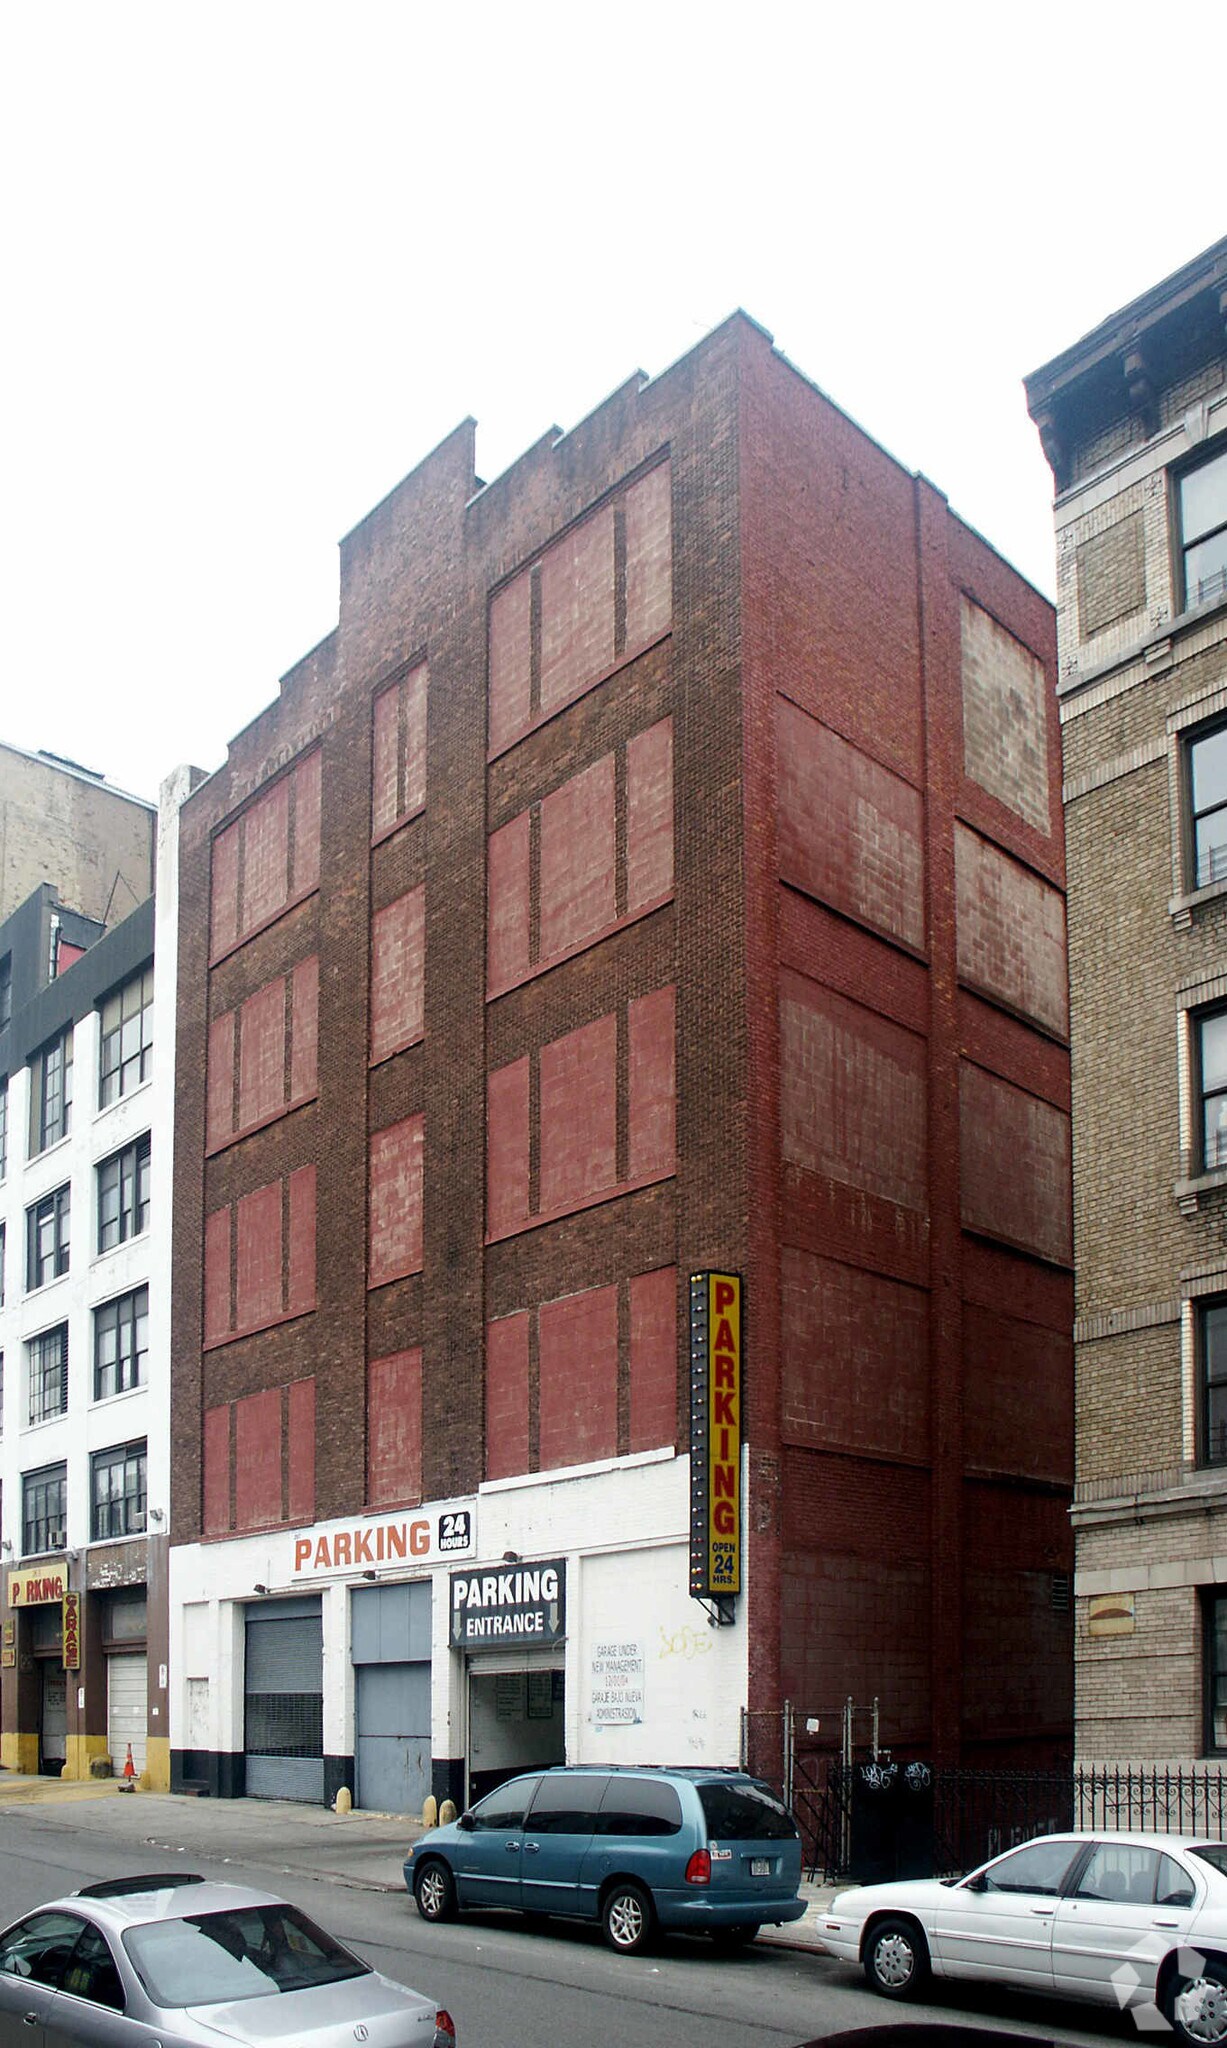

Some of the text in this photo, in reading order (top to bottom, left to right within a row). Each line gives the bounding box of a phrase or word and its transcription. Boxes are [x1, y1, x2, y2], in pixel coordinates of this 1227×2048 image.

[714, 1281, 736, 1536] PARKING
[442, 1514, 467, 1538] 24
[295, 1520, 431, 1572] PARKING
[440, 1535, 469, 1551] HOURS
[712, 1541, 736, 1553] OPEN
[713, 1554, 735, 1575] 24
[12, 1575, 63, 1605] PRKING
[453, 1568, 559, 1610] PARKING
[712, 1574, 736, 1585] HRS.
[65, 1594, 78, 1668] GARAGE
[466, 1611, 545, 1637] ENTRANCE
[597, 1643, 638, 1657] GARAGE UNDER
